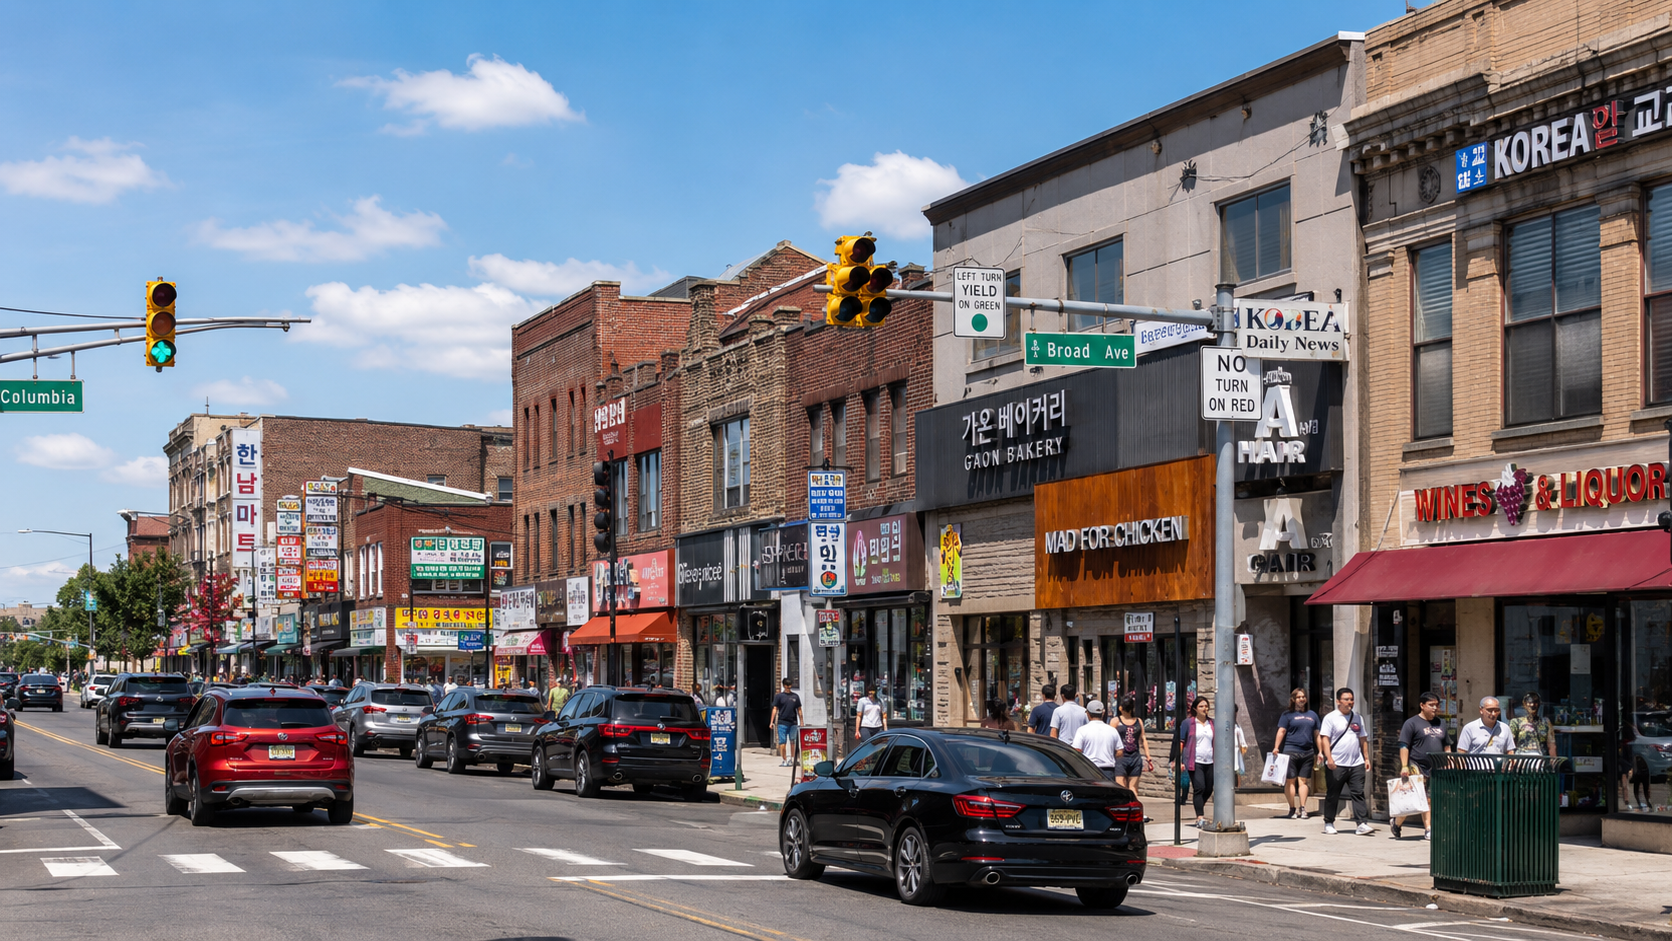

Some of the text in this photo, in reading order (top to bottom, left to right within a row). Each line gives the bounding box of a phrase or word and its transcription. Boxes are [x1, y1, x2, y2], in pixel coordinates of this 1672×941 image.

[1632, 86, 1672, 137] 교
[1494, 112, 1590, 180] KOREA
[957, 272, 1002, 282] LEFT TURN
[962, 284, 997, 297] YIELD
[958, 299, 1001, 310] ON GREEN
[1047, 342, 1129, 359] Broad Ave
[1246, 335, 1339, 353] Daily News
[1218, 355, 1246, 372] NO
[1215, 378, 1248, 392] TURN
[1, 389, 75, 404] Columbia
[1209, 397, 1255, 412] ON RED
[962, 389, 1066, 446] 가온 베이커리
[964, 436, 1063, 471] GAON BAKERY
[1238, 441, 1306, 464] HAIR
[236, 443, 258, 552] 한남마트
[1414, 462, 1666, 522] WINES & LIQUOR
[1045, 515, 1185, 555] MAD FOR CHICKEN
